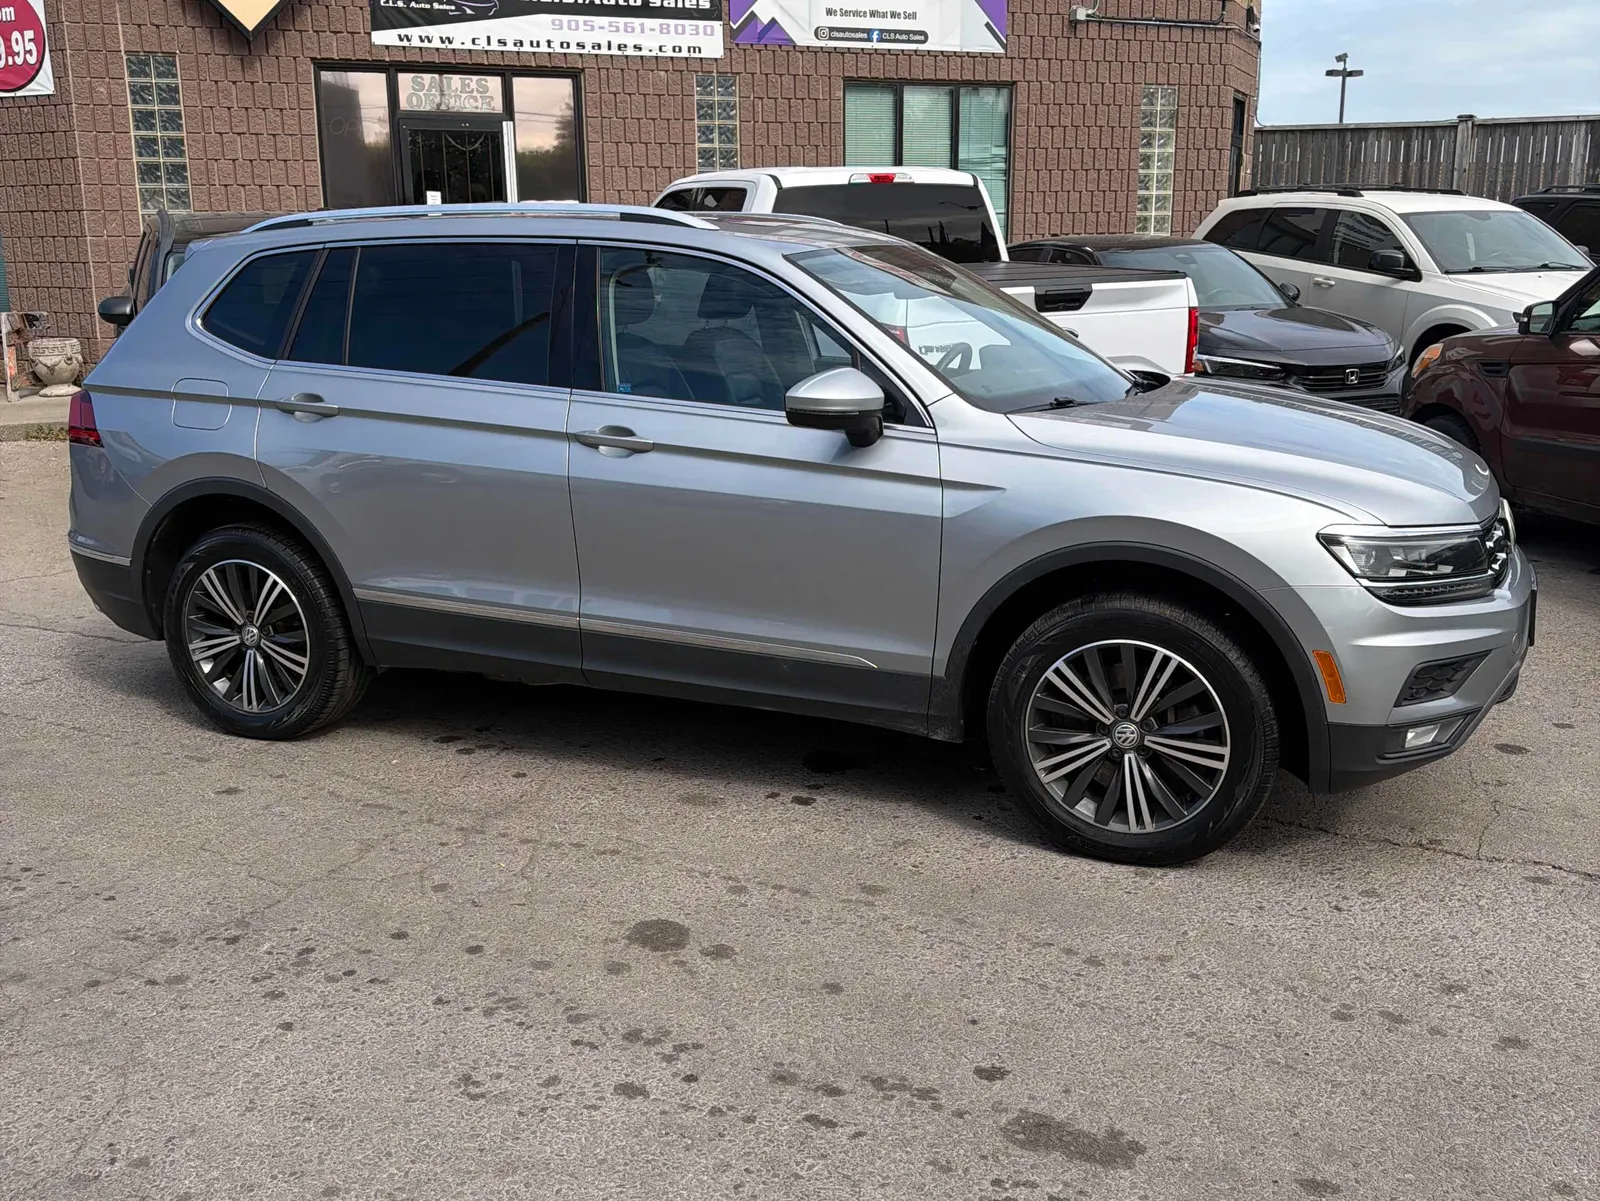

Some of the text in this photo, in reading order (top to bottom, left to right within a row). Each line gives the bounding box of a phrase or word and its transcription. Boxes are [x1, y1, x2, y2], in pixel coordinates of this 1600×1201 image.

[409, 1, 431, 9] Auto
[432, 2, 456, 10] Sales
[0, 7, 15, 21] m
[825, 7, 917, 20] We Service What We Sell
[551, 18, 715, 37] 905-561-8030
[830, 30, 868, 39] clsautosales
[882, 32, 895, 40] CLS
[397, 33, 702, 54] www.clsautosales.com
[411, 75, 490, 94] SALES
[406, 92, 496, 111] OFFICE
